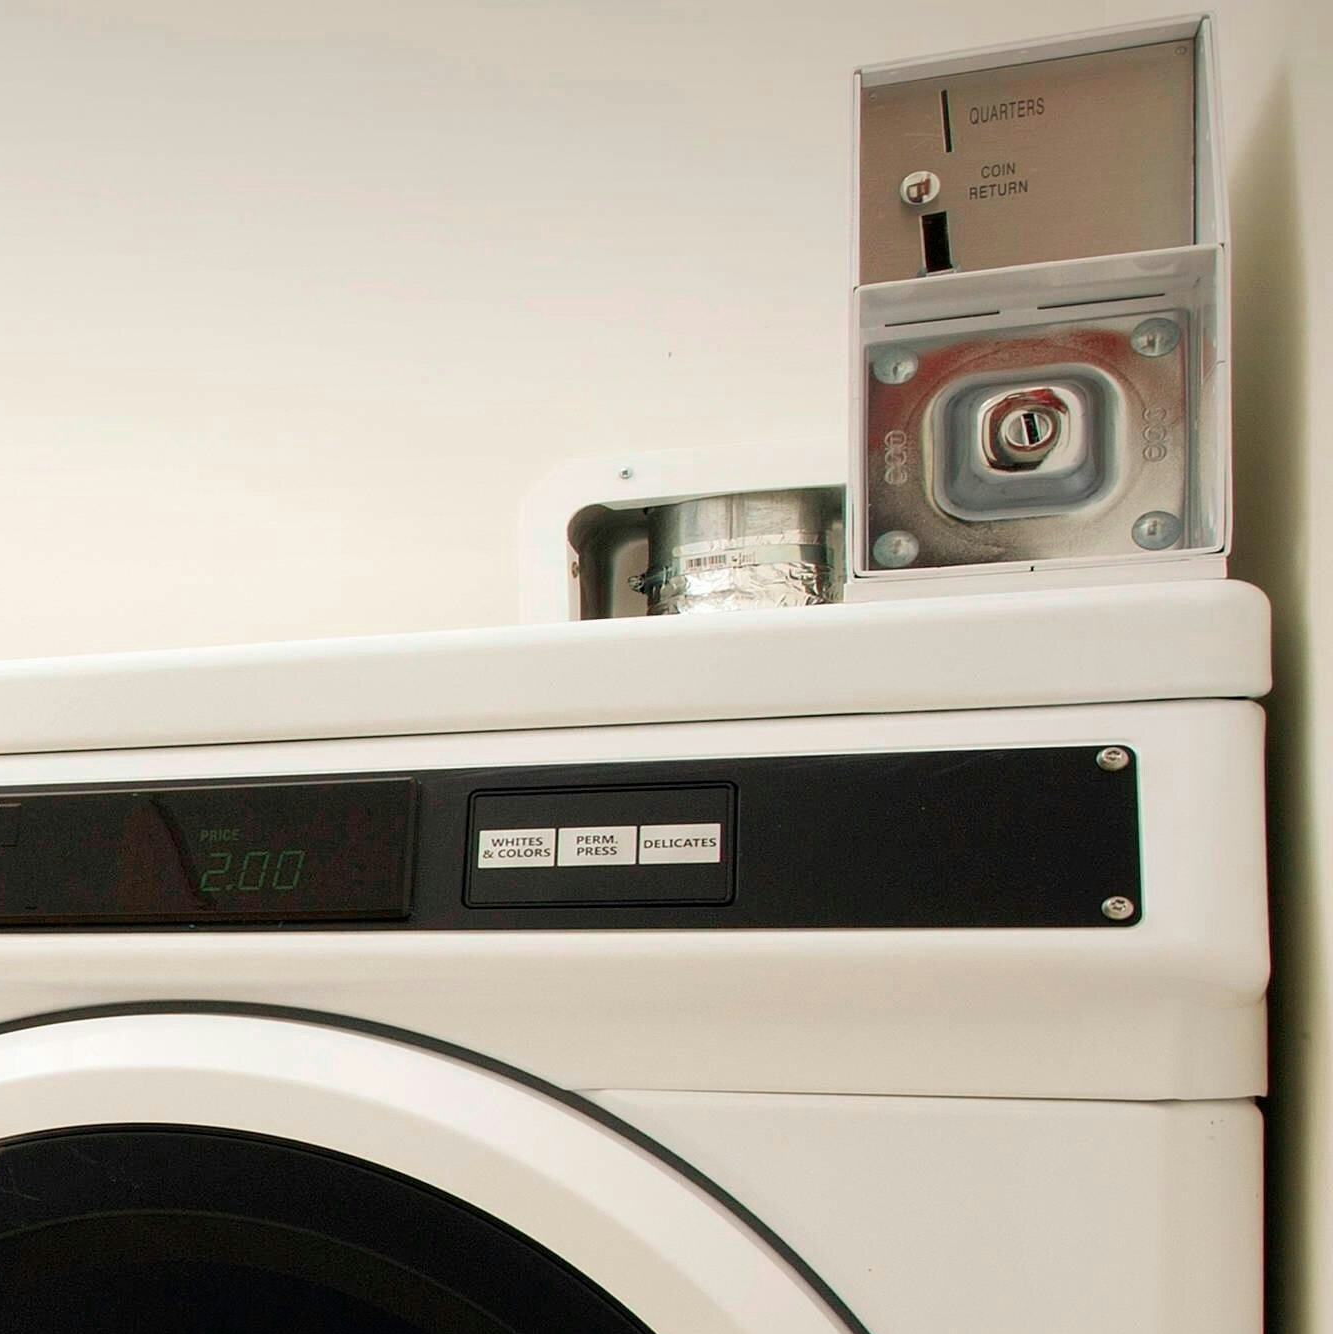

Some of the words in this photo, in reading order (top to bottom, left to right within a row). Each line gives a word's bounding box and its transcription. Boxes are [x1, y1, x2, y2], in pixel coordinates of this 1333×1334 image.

[969, 97, 1045, 125] QUARTERS
[980, 163, 1016, 179] COIN
[969, 180, 1029, 200] RETURN
[199, 829, 240, 842] PRICE
[491, 836, 543, 847] WHITES
[576, 834, 619, 845] PERM.
[643, 837, 717, 849] DELICATES
[482, 848, 494, 859] &
[497, 848, 551, 859] COLORS
[576, 846, 618, 857] PRESS
[200, 850, 305, 892] 2.00
